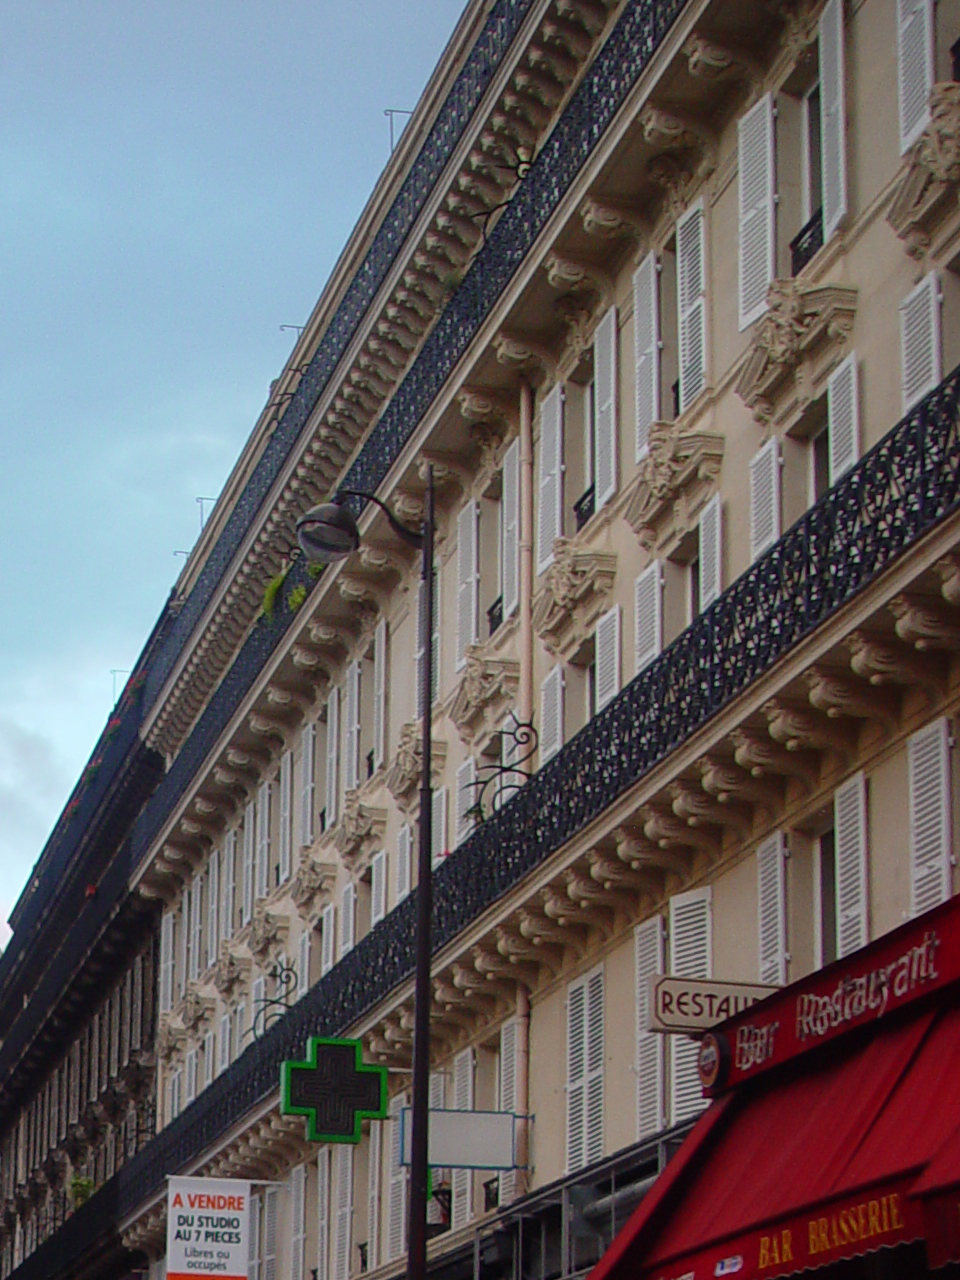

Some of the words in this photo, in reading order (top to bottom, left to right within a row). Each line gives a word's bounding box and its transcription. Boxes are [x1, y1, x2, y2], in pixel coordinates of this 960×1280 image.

[660, 990, 762, 1019] RESTAU
[735, 1021, 779, 1071] Bar
[795, 930, 941, 1042] Restaurant
[172, 1193, 183, 1208] A
[186, 1194, 245, 1211] VENDRE
[177, 1215, 194, 1227] DU
[197, 1216, 240, 1228] STUDIO
[174, 1230, 191, 1241] AU
[195, 1230, 202, 1242] 7
[205, 1231, 241, 1244] PIECES
[758, 1229, 793, 1269] BAR
[808, 1193, 904, 1255] BRASSERIE
[184, 1247, 214, 1259] Libres
[216, 1250, 230, 1259] ou
[187, 1258, 227, 1271] occupés
